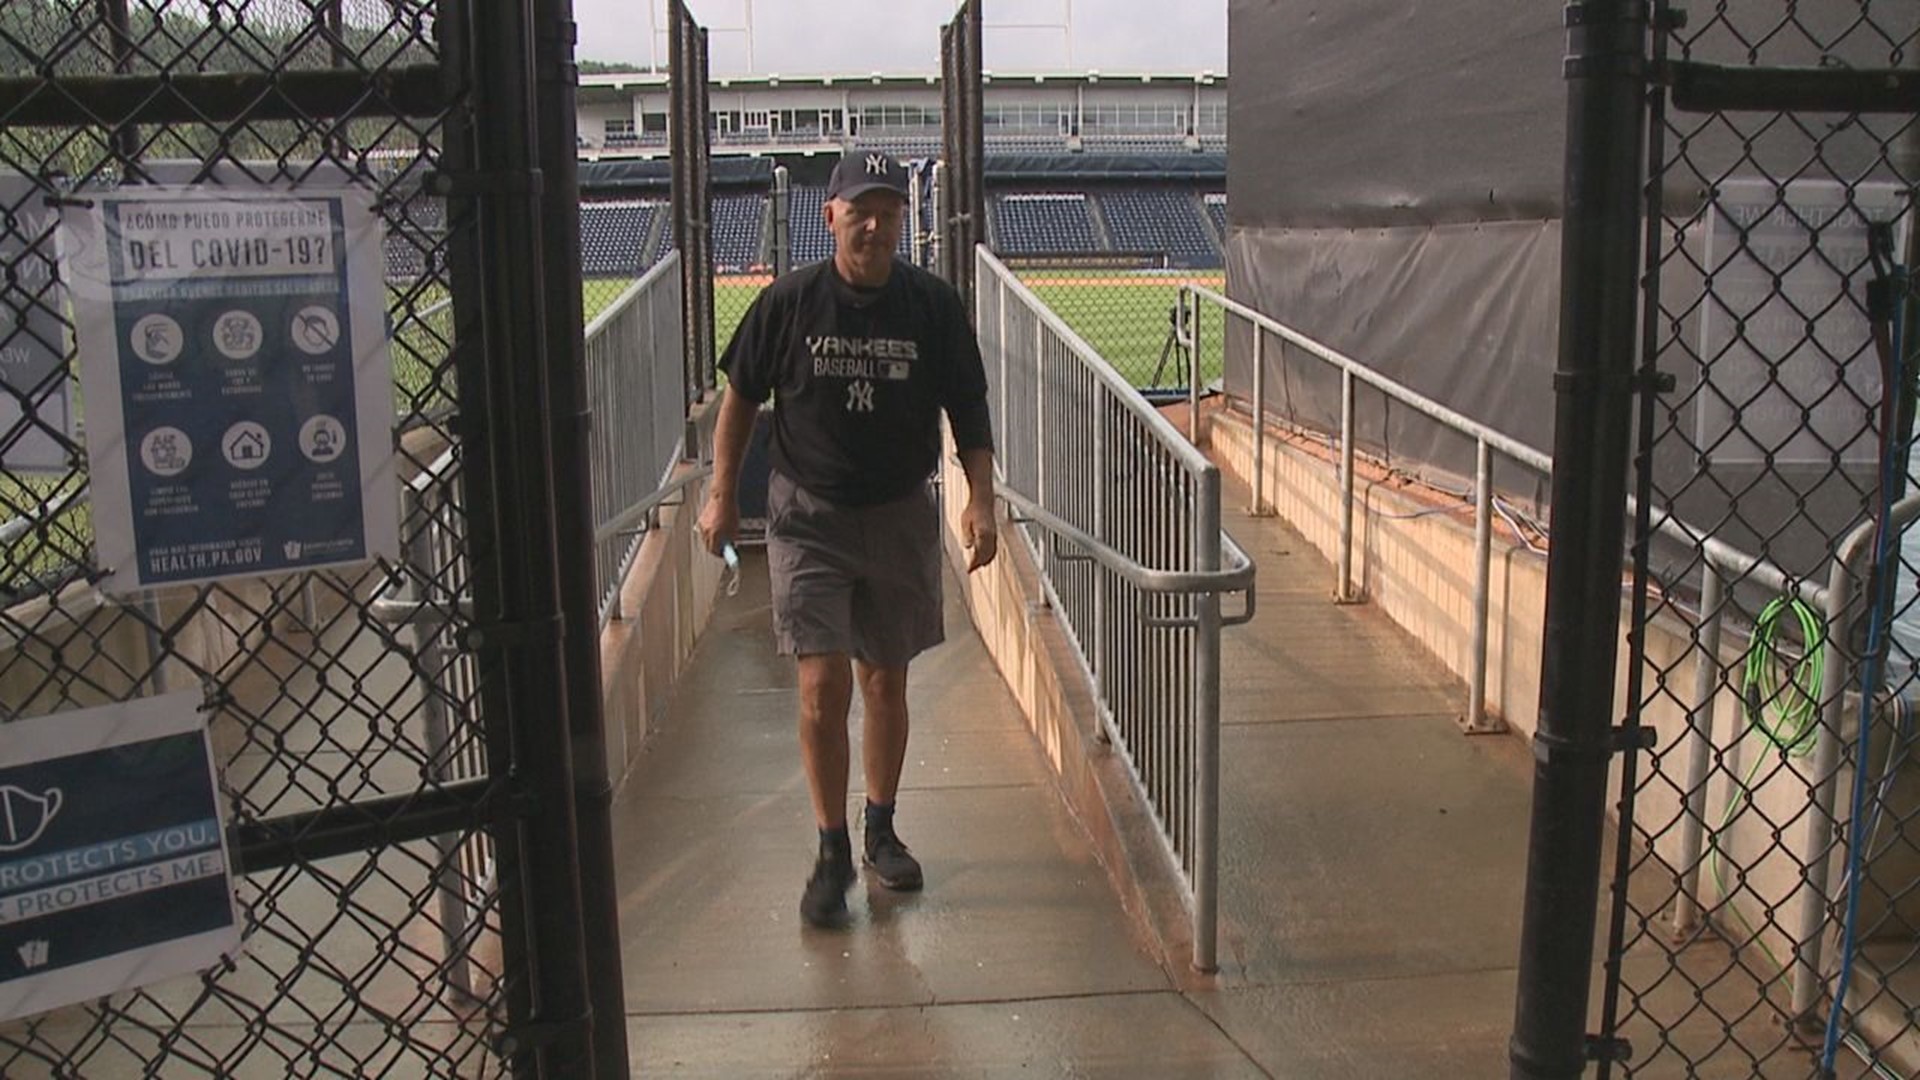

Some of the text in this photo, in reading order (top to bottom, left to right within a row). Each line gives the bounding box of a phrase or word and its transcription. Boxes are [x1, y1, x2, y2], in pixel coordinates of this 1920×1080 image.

[865, 153, 887, 175] NY
[184, 211, 230, 229] PUEDO
[130, 235, 325, 271] DEL COVID-19?
[805, 336, 918, 360] YANKEES
[814, 357, 875, 378] BASEBALL
[846, 379, 874, 412] NY
[150, 547, 263, 575] HEALTH.PA.GOV
[146, 823, 216, 852] YOU.
[17, 864, 164, 917] PROTECTS
[173, 856, 221, 881] ME.
